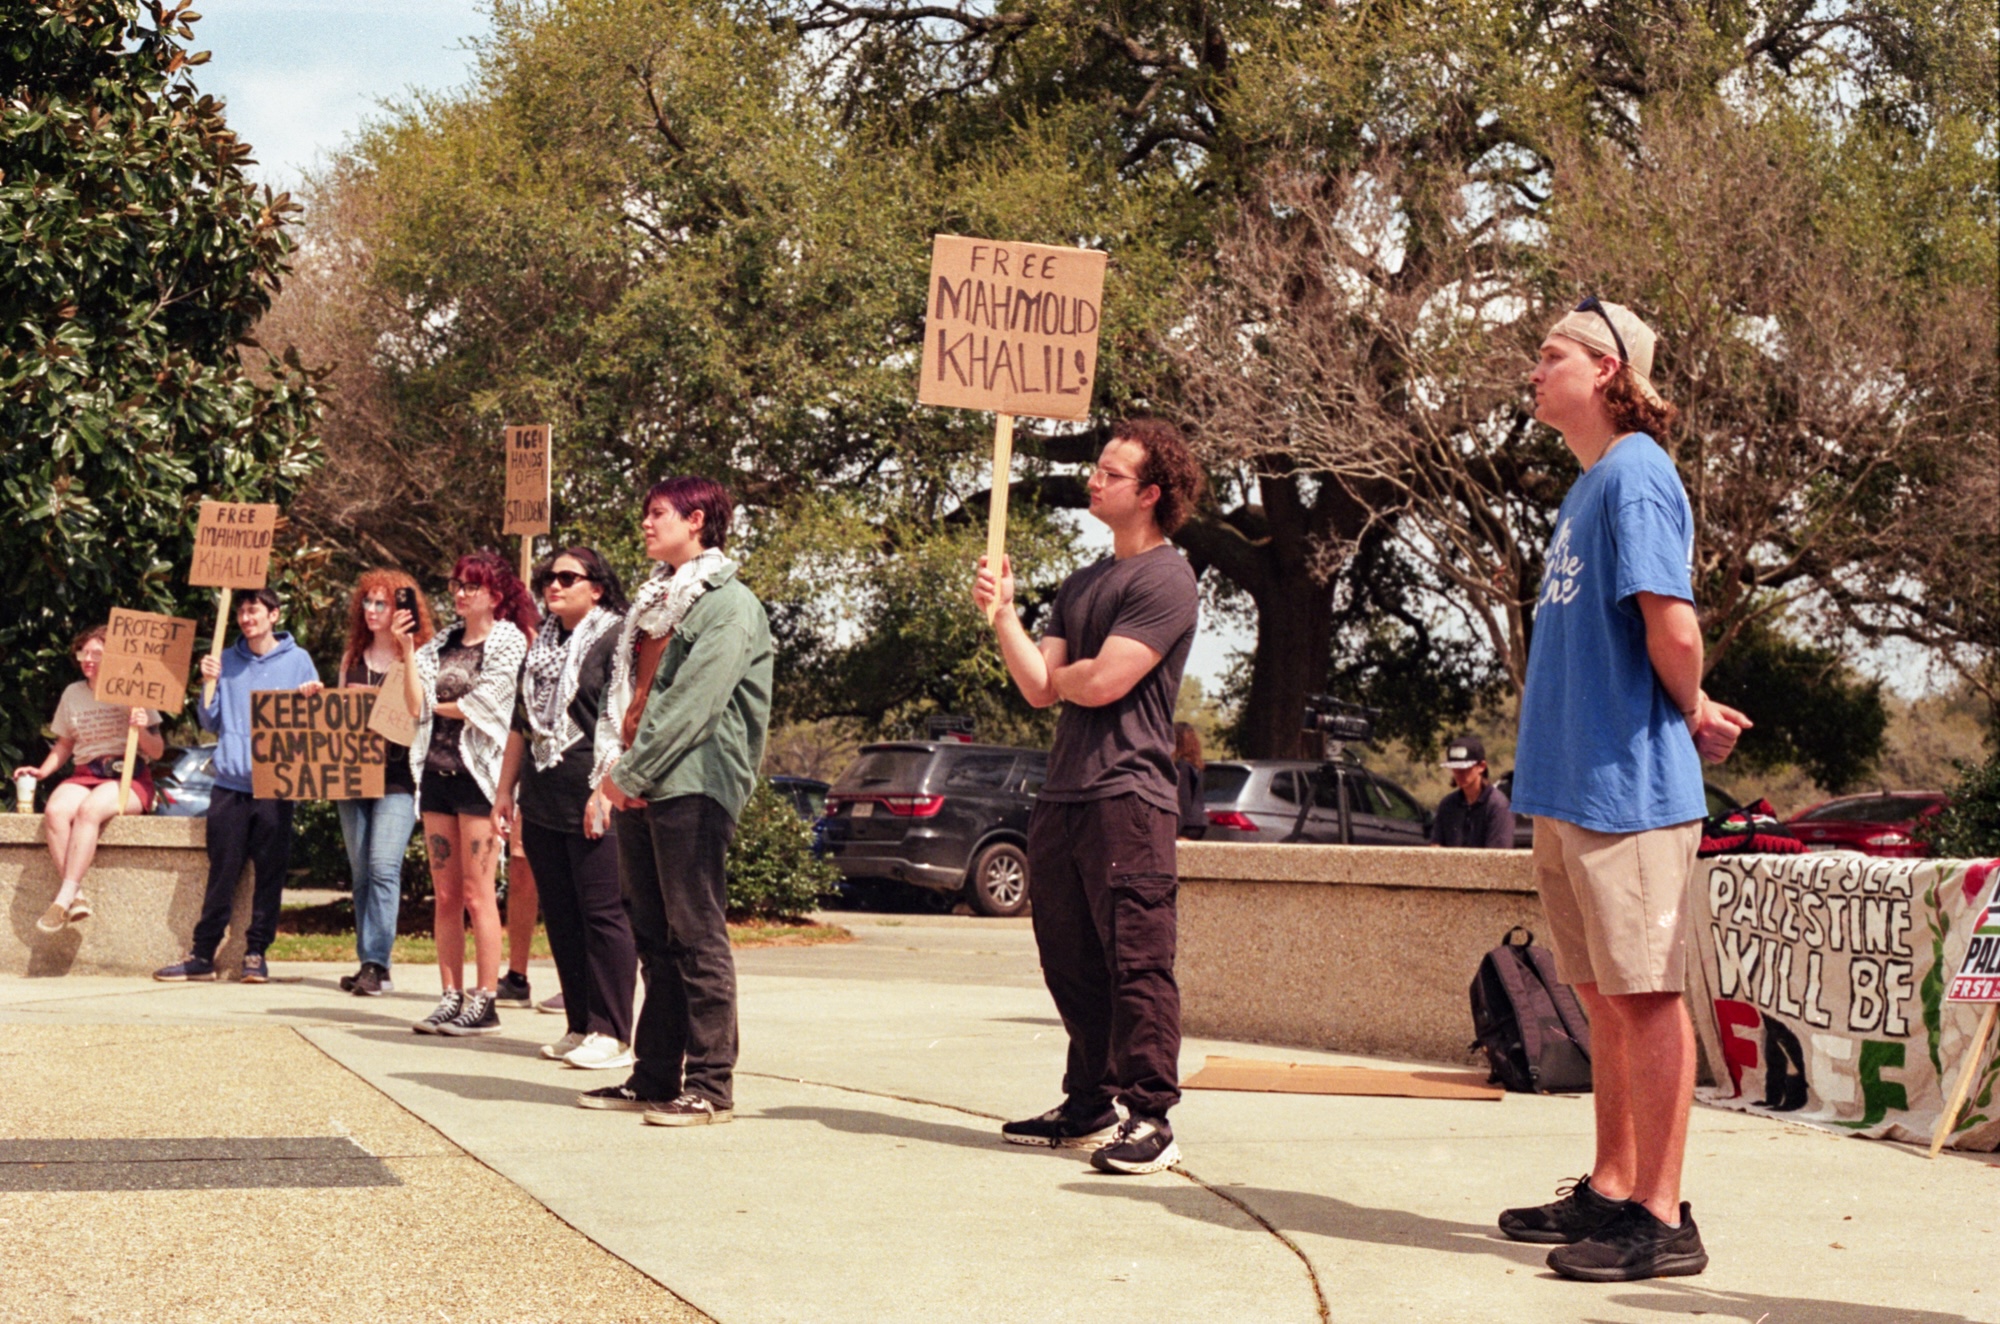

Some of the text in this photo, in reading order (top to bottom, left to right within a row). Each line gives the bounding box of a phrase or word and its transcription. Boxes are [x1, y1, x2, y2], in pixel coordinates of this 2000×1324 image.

[970, 246, 1057, 280] FREE
[936, 276, 1098, 337] MAHMOUD
[938, 329, 1088, 395] KHALIL!
[511, 451, 544, 469] HANDS
[515, 469, 545, 486] OFF!
[217, 507, 256, 523] FREE
[200, 526, 271, 549] MAHMOUD
[197, 550, 262, 579] KHALIL
[113, 616, 186, 640] PROTEST
[123, 638, 170, 656] IS NOT
[132, 661, 144, 675] A
[105, 677, 166, 705] CRIME!
[251, 692, 323, 730] KEEP
[251, 731, 385, 765] CAMPUSES
[273, 762, 362, 799] SAFE
[1709, 867, 1913, 957] PALESTINE
[1960, 937, 2000, 974] PAL
[1710, 922, 1914, 1037] WILL BE
